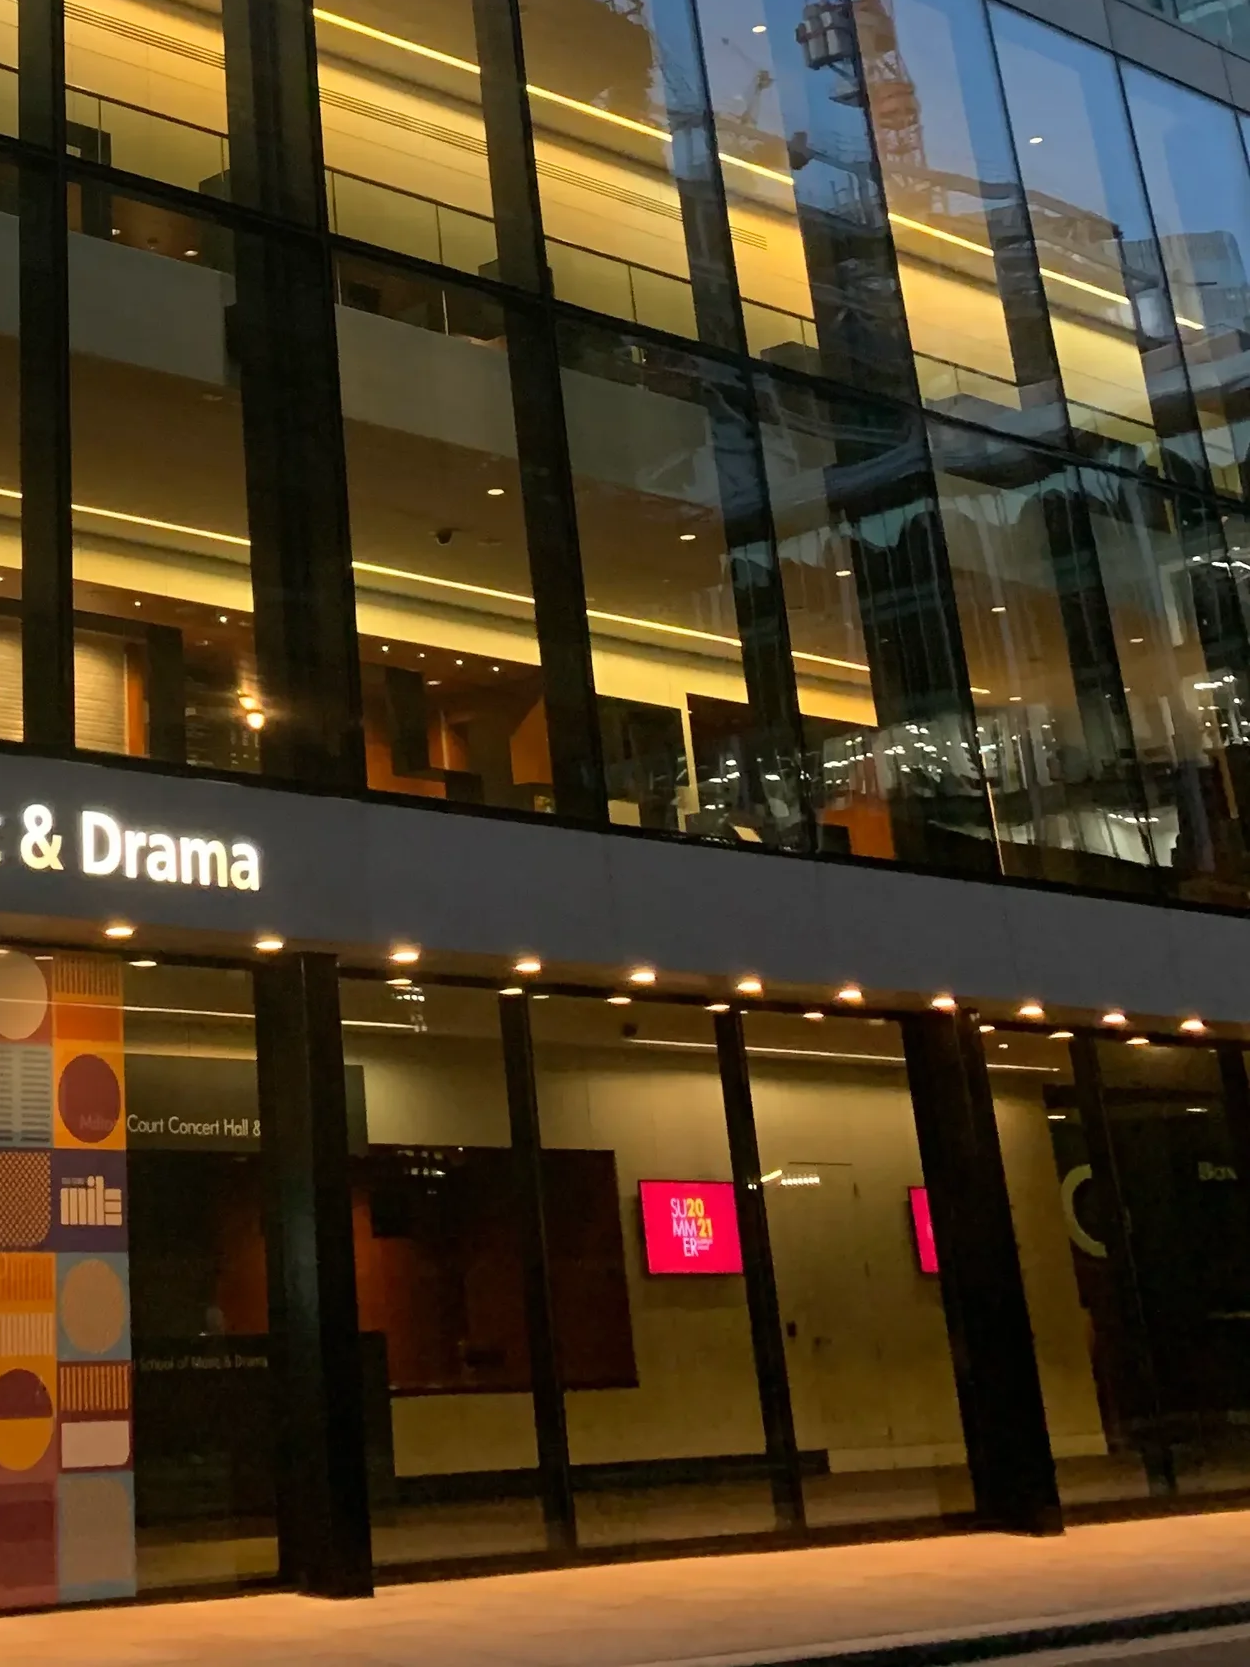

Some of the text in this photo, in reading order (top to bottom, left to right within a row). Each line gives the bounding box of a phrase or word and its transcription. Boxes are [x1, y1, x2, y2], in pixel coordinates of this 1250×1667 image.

[20, 804, 64, 871] &
[81, 810, 261, 892] Drama
[126, 1114, 164, 1133] Court
[168, 1116, 220, 1135] Concert
[223, 1118, 249, 1137] Hall
[252, 1119, 261, 1137] &
